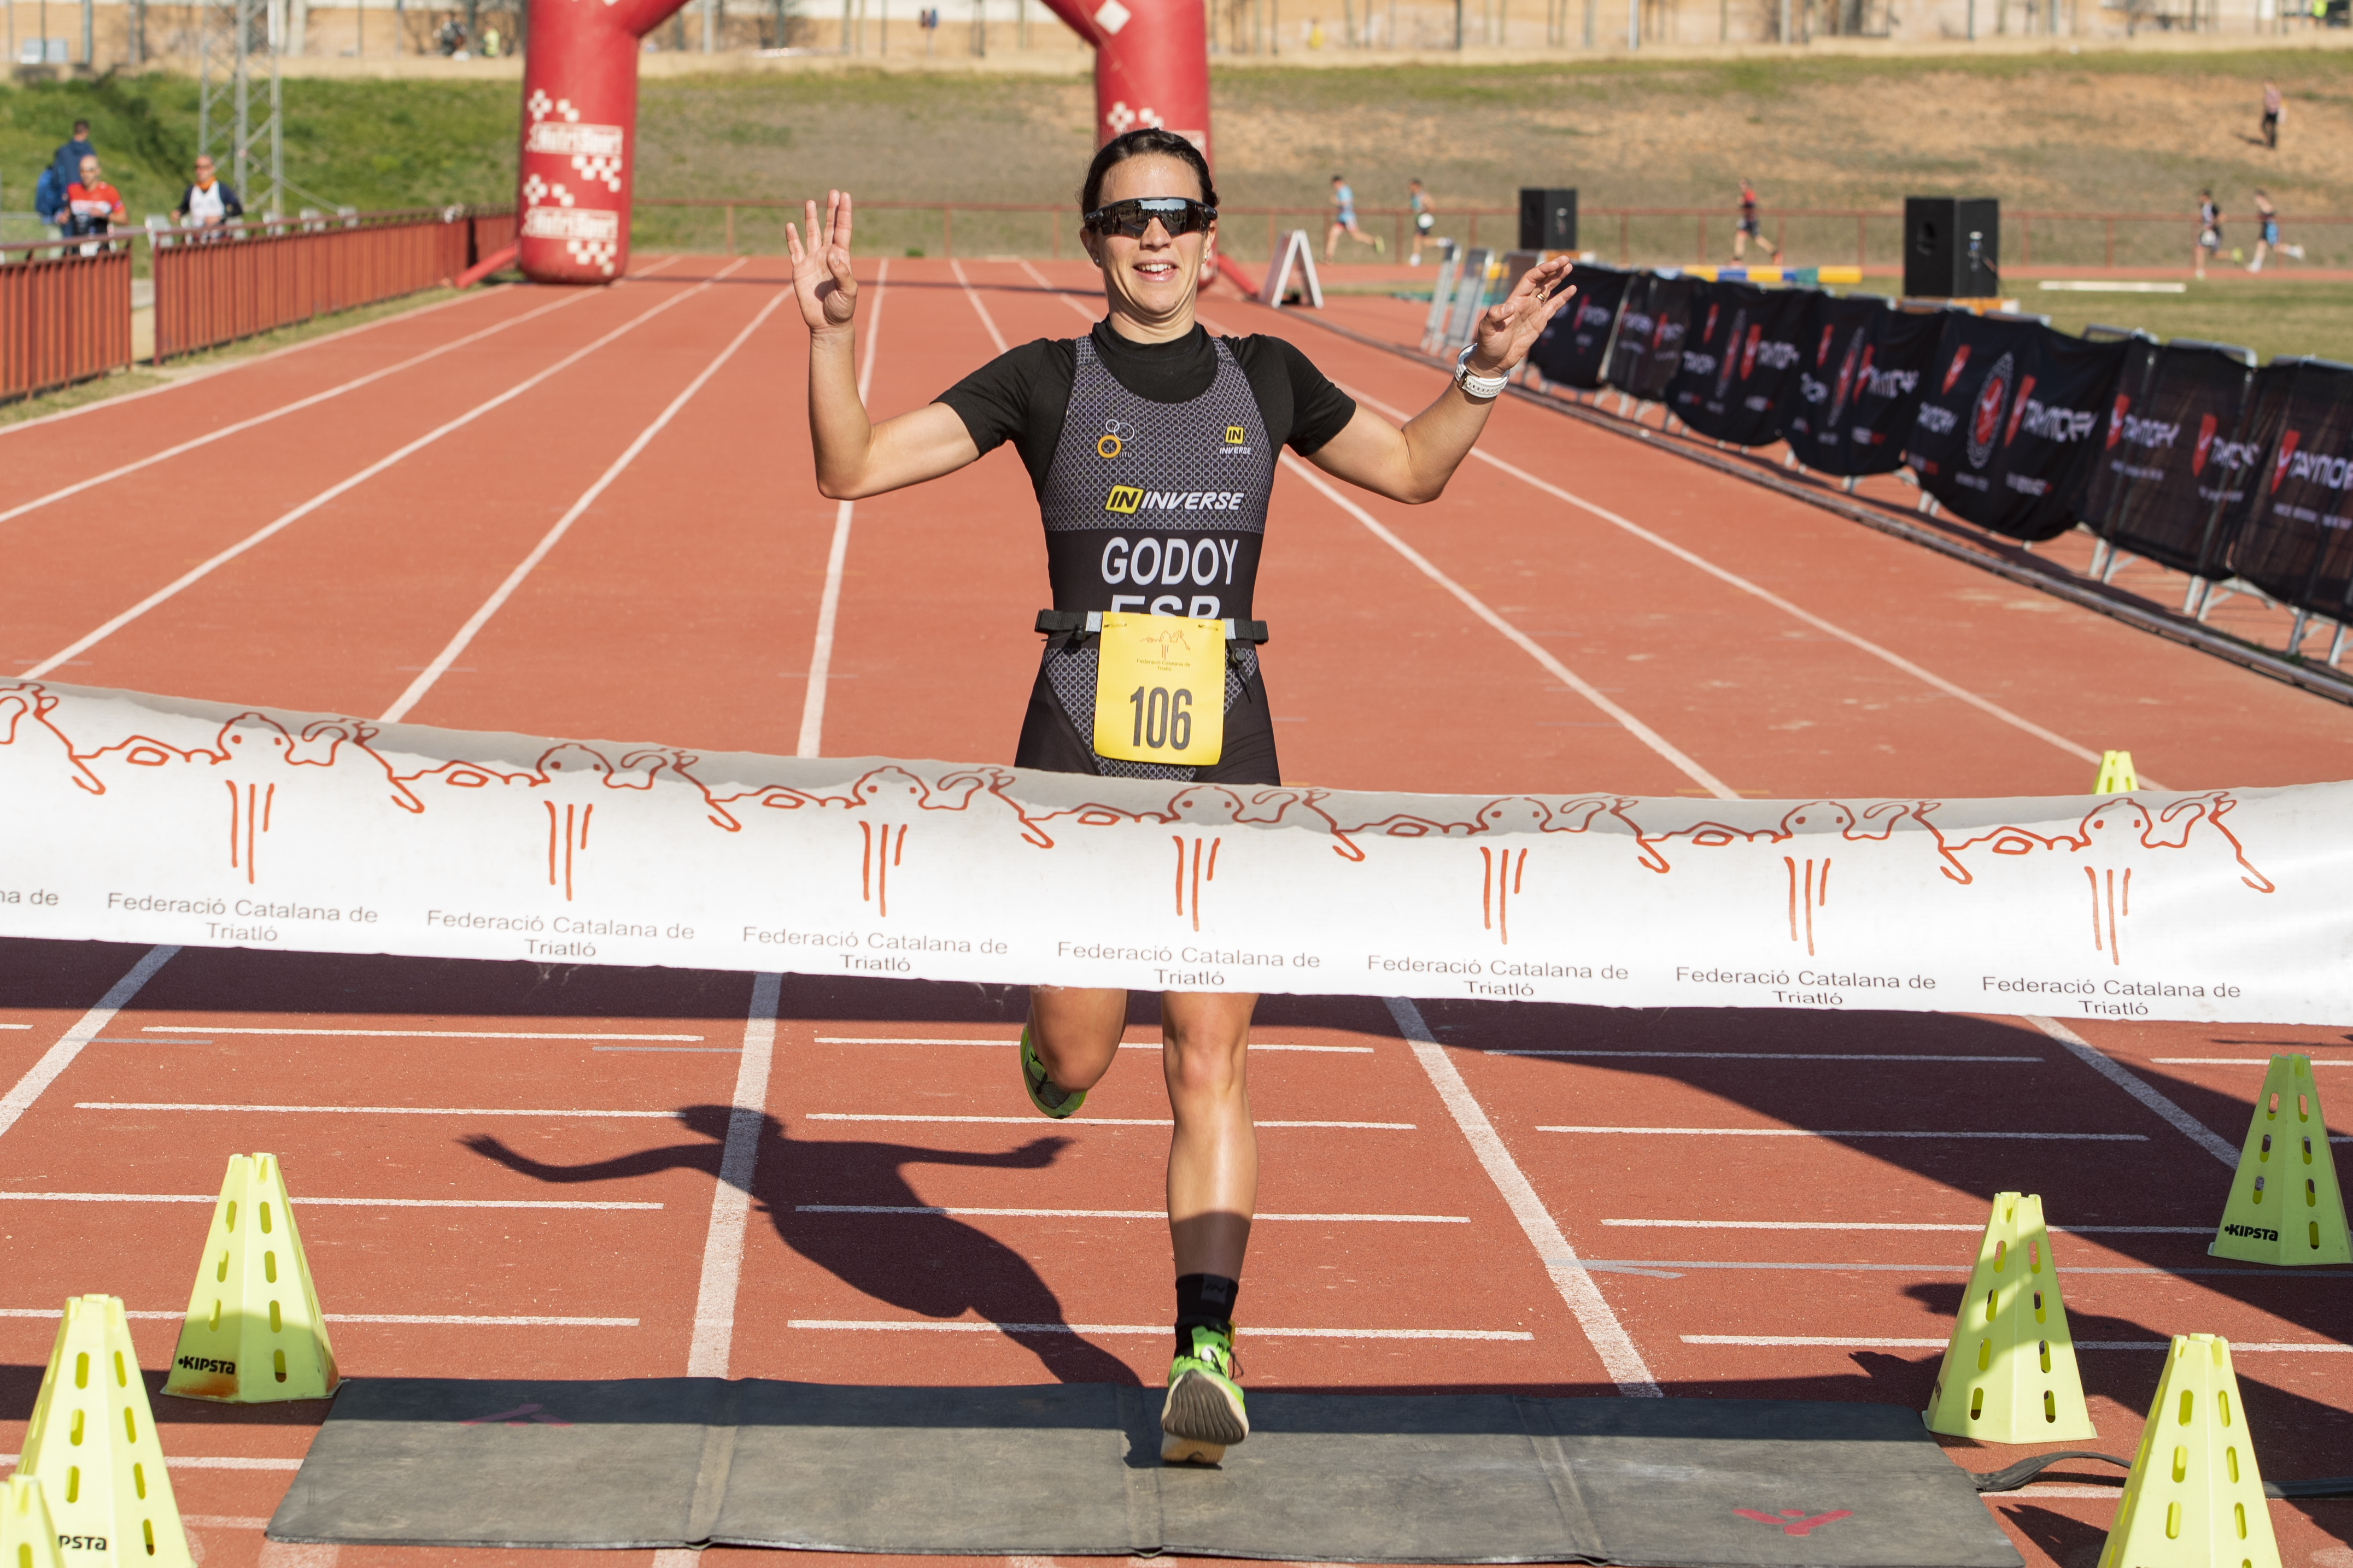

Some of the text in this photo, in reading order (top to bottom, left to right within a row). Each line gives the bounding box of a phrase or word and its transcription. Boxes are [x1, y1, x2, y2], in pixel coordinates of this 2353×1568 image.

[1219, 447, 1251, 455] INVERSE
[1140, 491, 1244, 510] INVERSE
[1101, 536, 1239, 586] GODOY
[1129, 686, 1192, 750] 106
[31, 888, 58, 906] de
[108, 892, 378, 923] Federació Catalana de
[206, 922, 278, 942] Triatló
[428, 910, 694, 939] Federació Catalana de
[525, 939, 596, 957] Triatló
[744, 926, 1008, 954] Federació Catalana de
[840, 954, 911, 972] Triatló
[1058, 941, 1320, 968] Federació Catalana de
[1154, 968, 1225, 985] Triatló
[1368, 955, 1629, 980] Federació Catalana de
[1464, 980, 1535, 996] Triatló
[1676, 966, 1936, 990] Federació Catalana de
[1982, 976, 2241, 998] Federació Catalana de
[1772, 990, 1843, 1006] Triatló
[2077, 1000, 2149, 1015] Triatló
